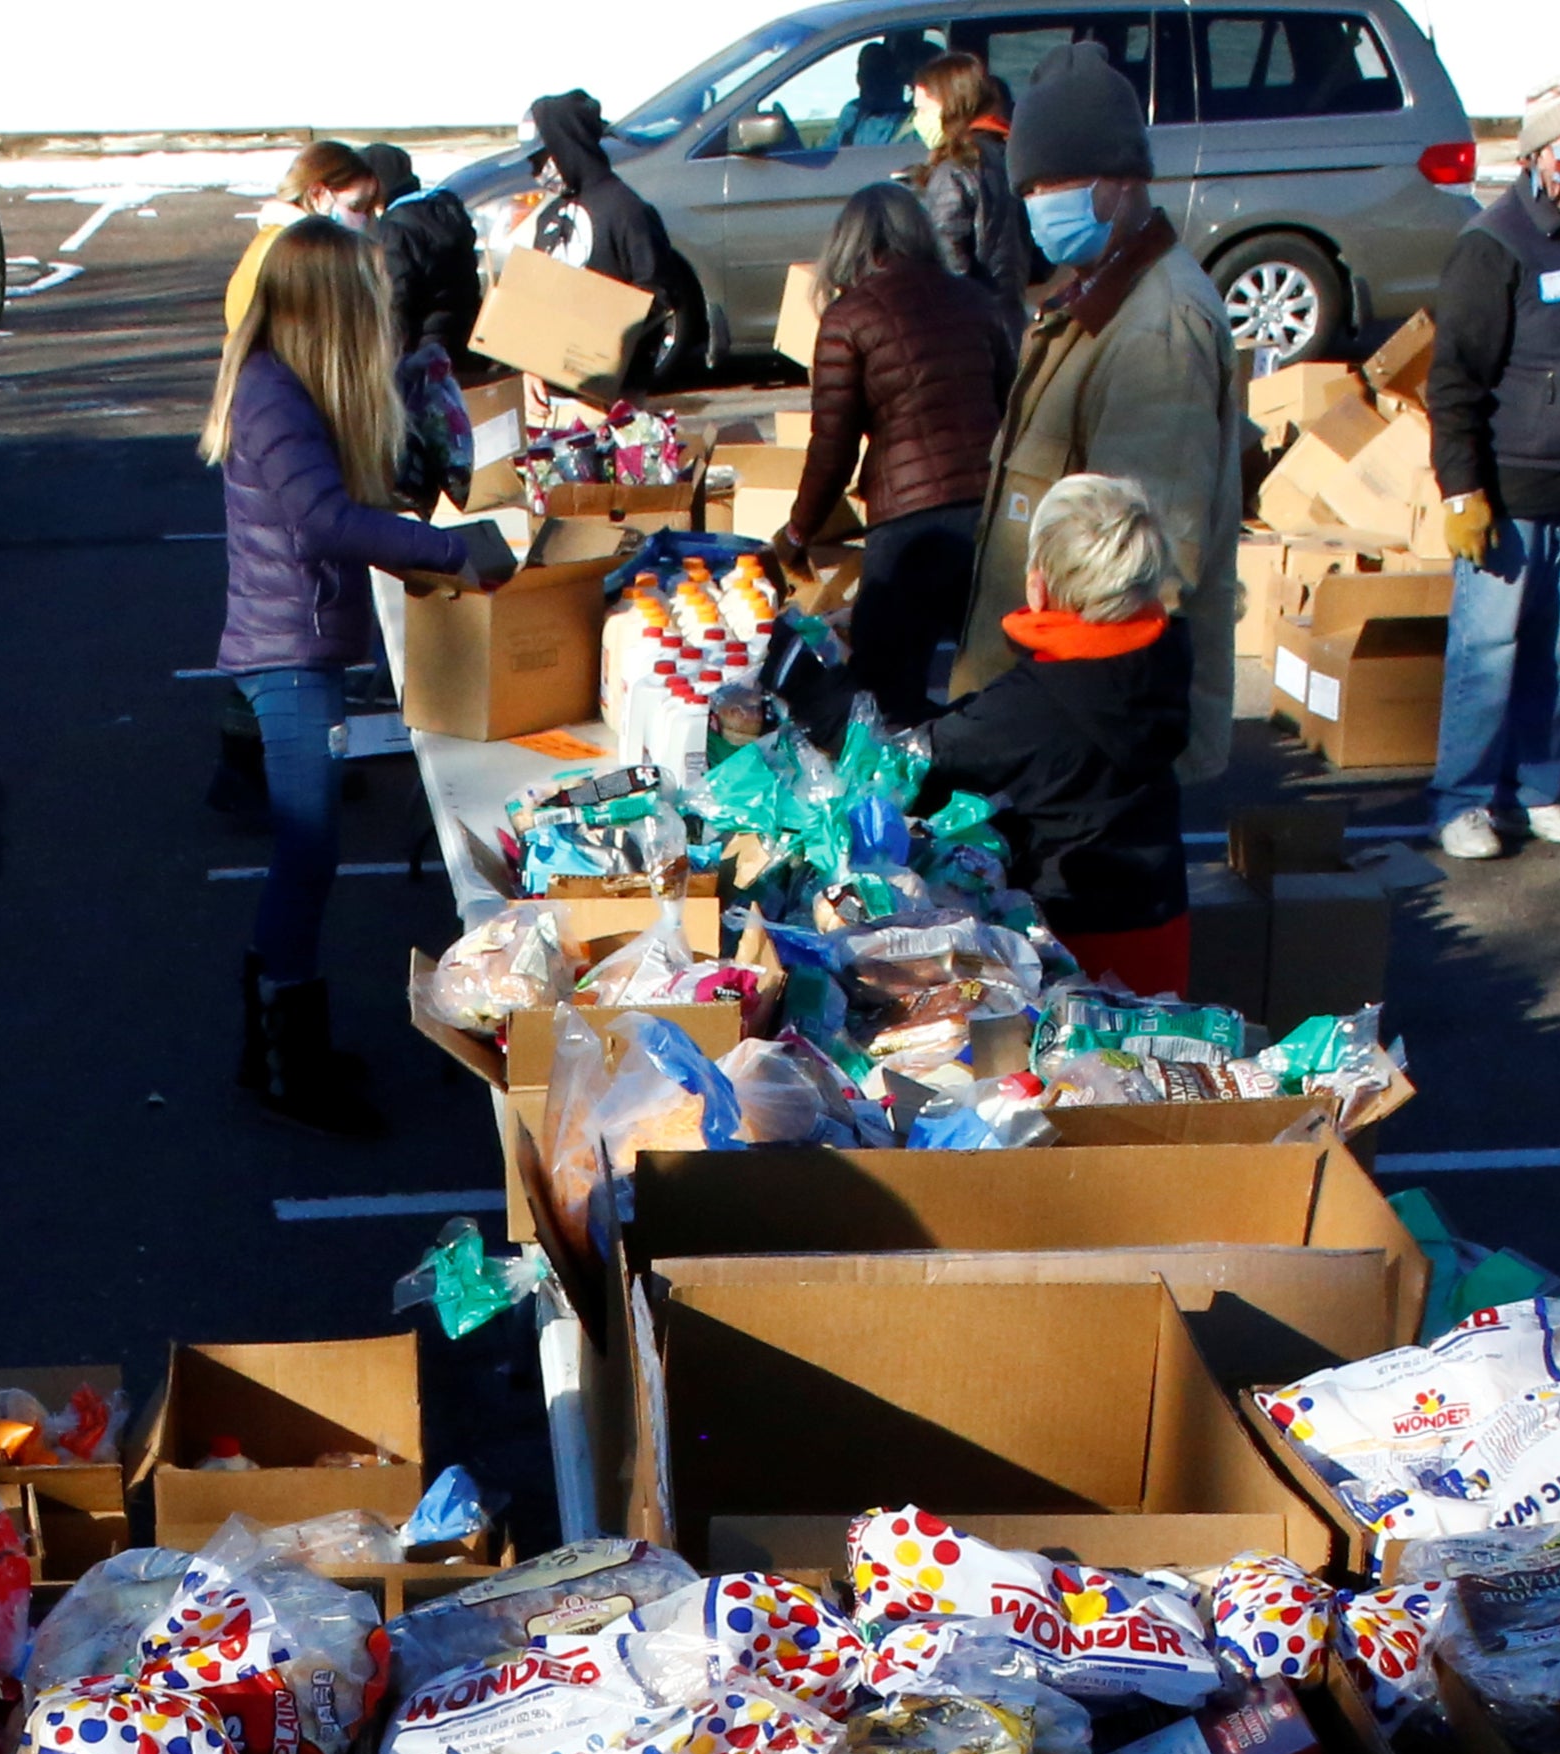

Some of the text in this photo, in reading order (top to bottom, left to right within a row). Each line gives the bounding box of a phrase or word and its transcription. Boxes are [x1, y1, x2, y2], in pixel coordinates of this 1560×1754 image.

[1392, 1402, 1471, 1435] WONDER
[990, 1595, 1188, 1656] WONDER
[406, 1657, 601, 1722] WONDER
